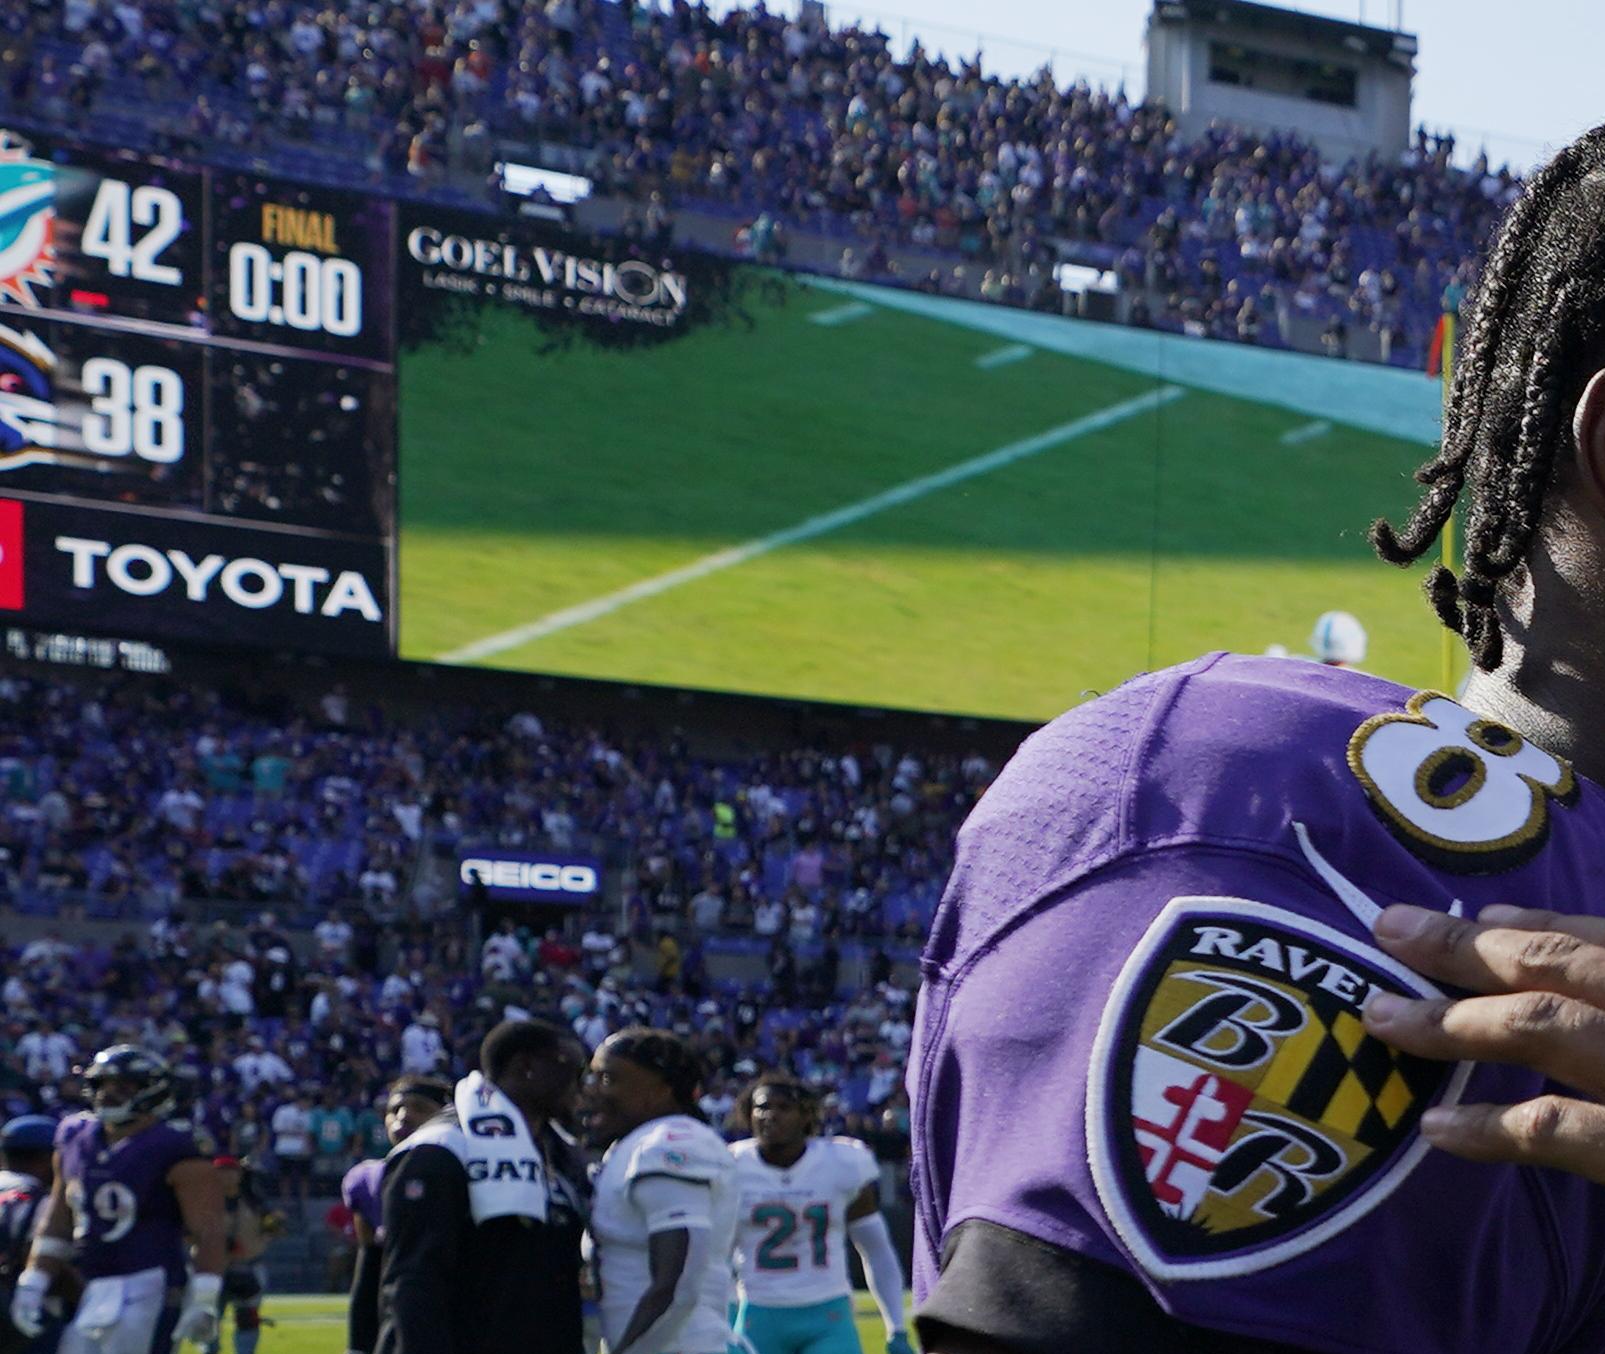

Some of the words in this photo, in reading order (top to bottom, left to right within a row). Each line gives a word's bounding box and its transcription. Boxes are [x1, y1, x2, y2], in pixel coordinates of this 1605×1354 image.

[81, 178, 183, 286] 42
[261, 203, 340, 254] FINAL
[408, 226, 531, 281] GOEL
[533, 247, 687, 307] VISION
[229, 242, 362, 337] 0:00
[81, 357, 184, 463] 38
[54, 535, 382, 622] TOYOTA
[1346, 690, 1581, 875] 8
[461, 858, 595, 893] GEICO
[1156, 971, 1310, 1071] B
[466, 1160, 541, 1184] GAT
[1209, 1108, 1349, 1219] R
[750, 1201, 829, 1272] 21
